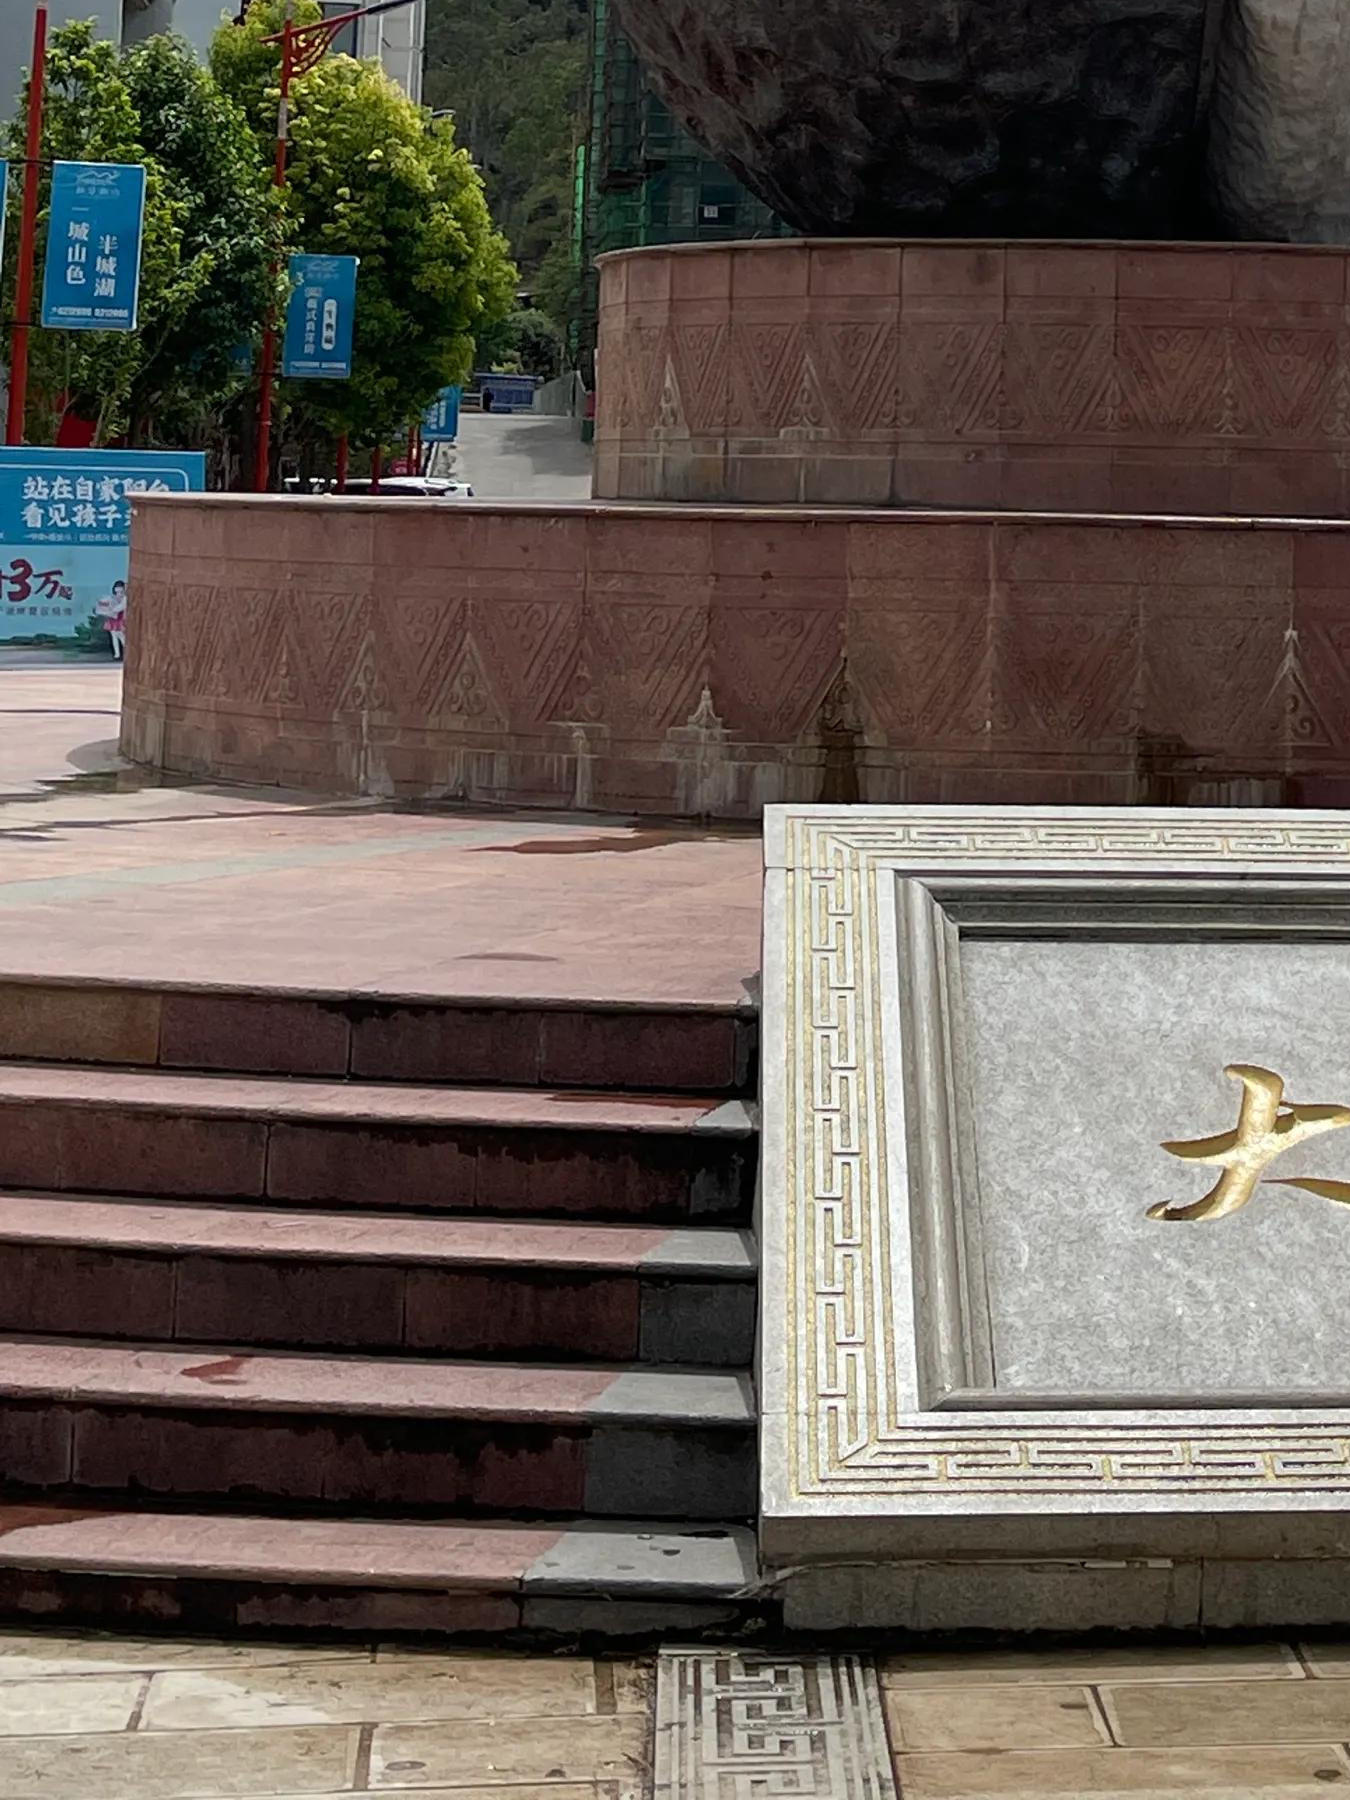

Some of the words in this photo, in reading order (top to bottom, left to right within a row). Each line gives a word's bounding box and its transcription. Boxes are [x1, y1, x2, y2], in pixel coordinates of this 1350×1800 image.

[66, 206, 90, 285] 一城山色
[93, 234, 119, 298] 半城湖
[20, 501, 132, 529] 看见孩子
